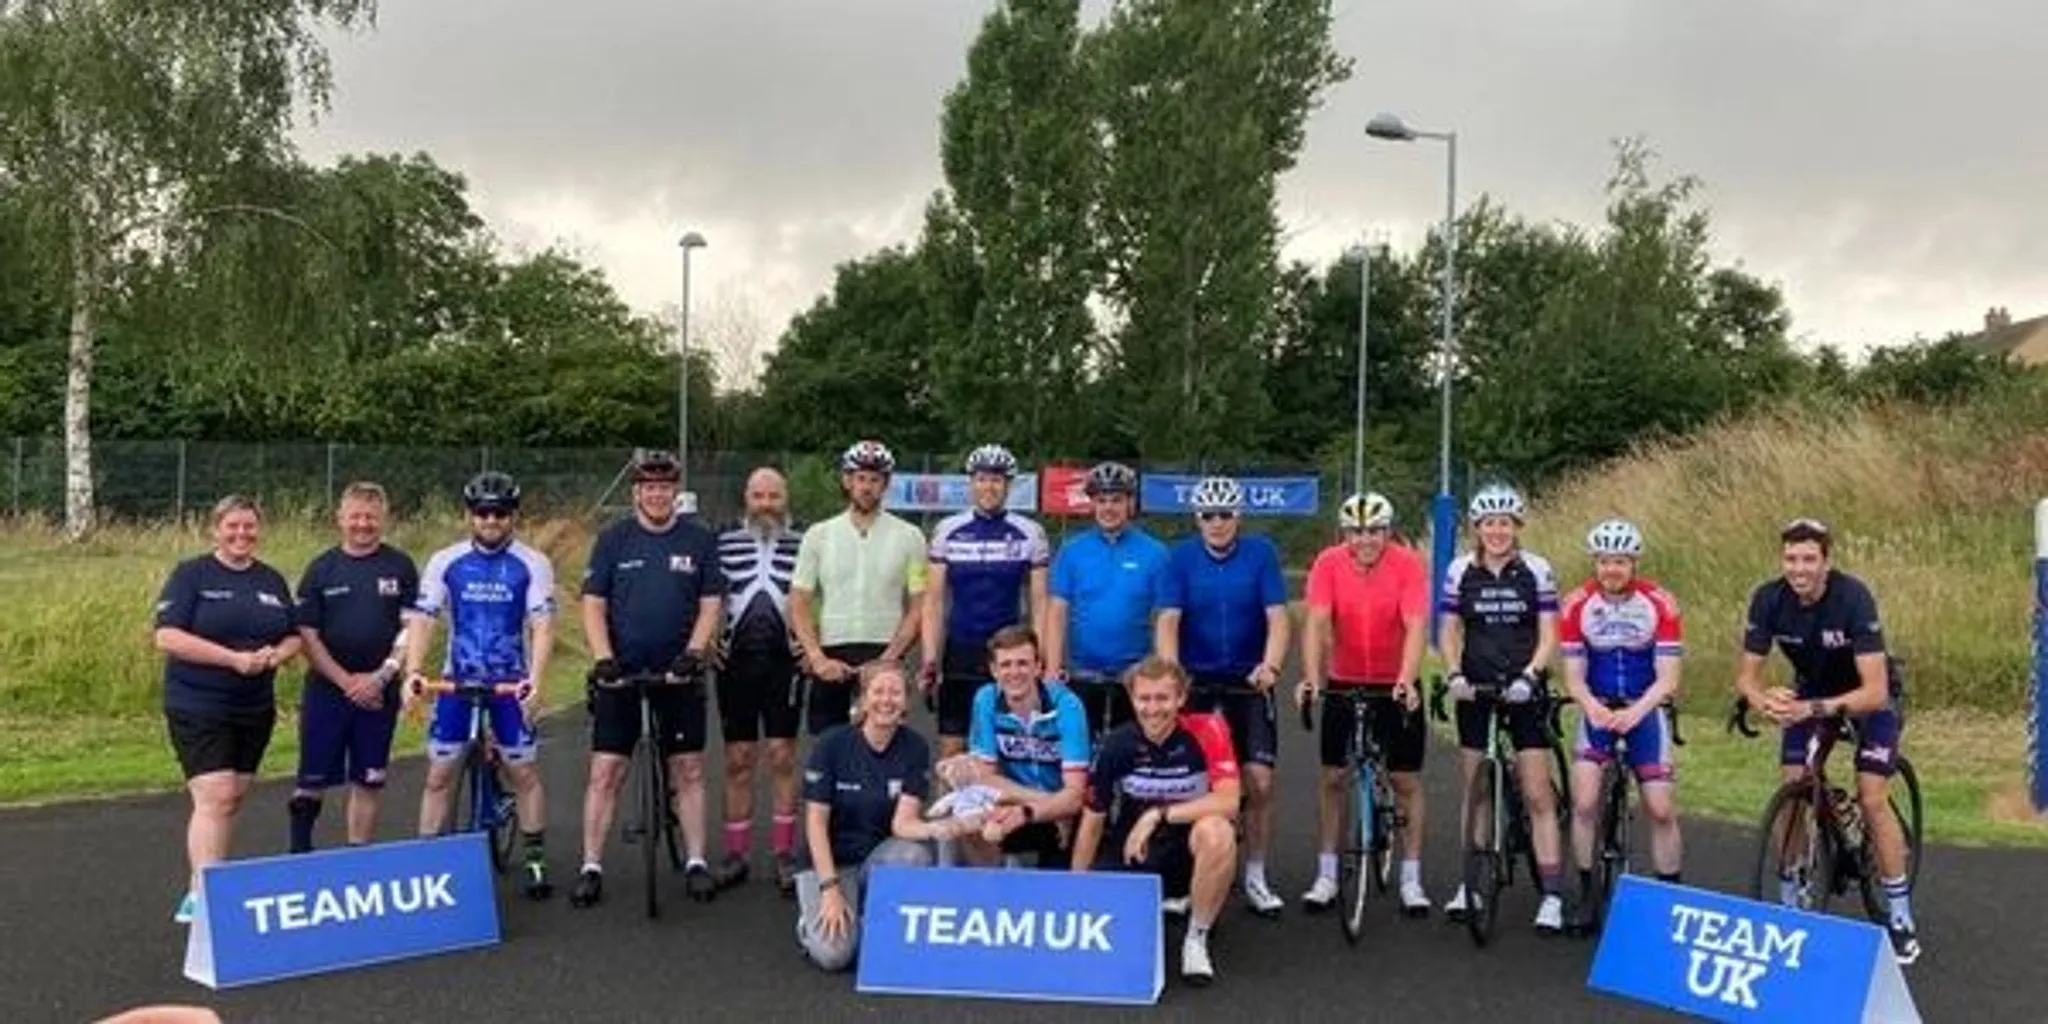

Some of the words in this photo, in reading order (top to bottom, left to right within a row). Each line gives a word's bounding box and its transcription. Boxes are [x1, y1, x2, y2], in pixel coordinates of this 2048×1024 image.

[1250, 486, 1285, 507] UK
[245, 883, 385, 934] TEAM
[391, 872, 455, 911] UK
[899, 905, 1036, 948] TEAM
[1043, 911, 1112, 951] UK
[1671, 904, 1807, 968] TEAM
[1686, 950, 1767, 1009] UK
